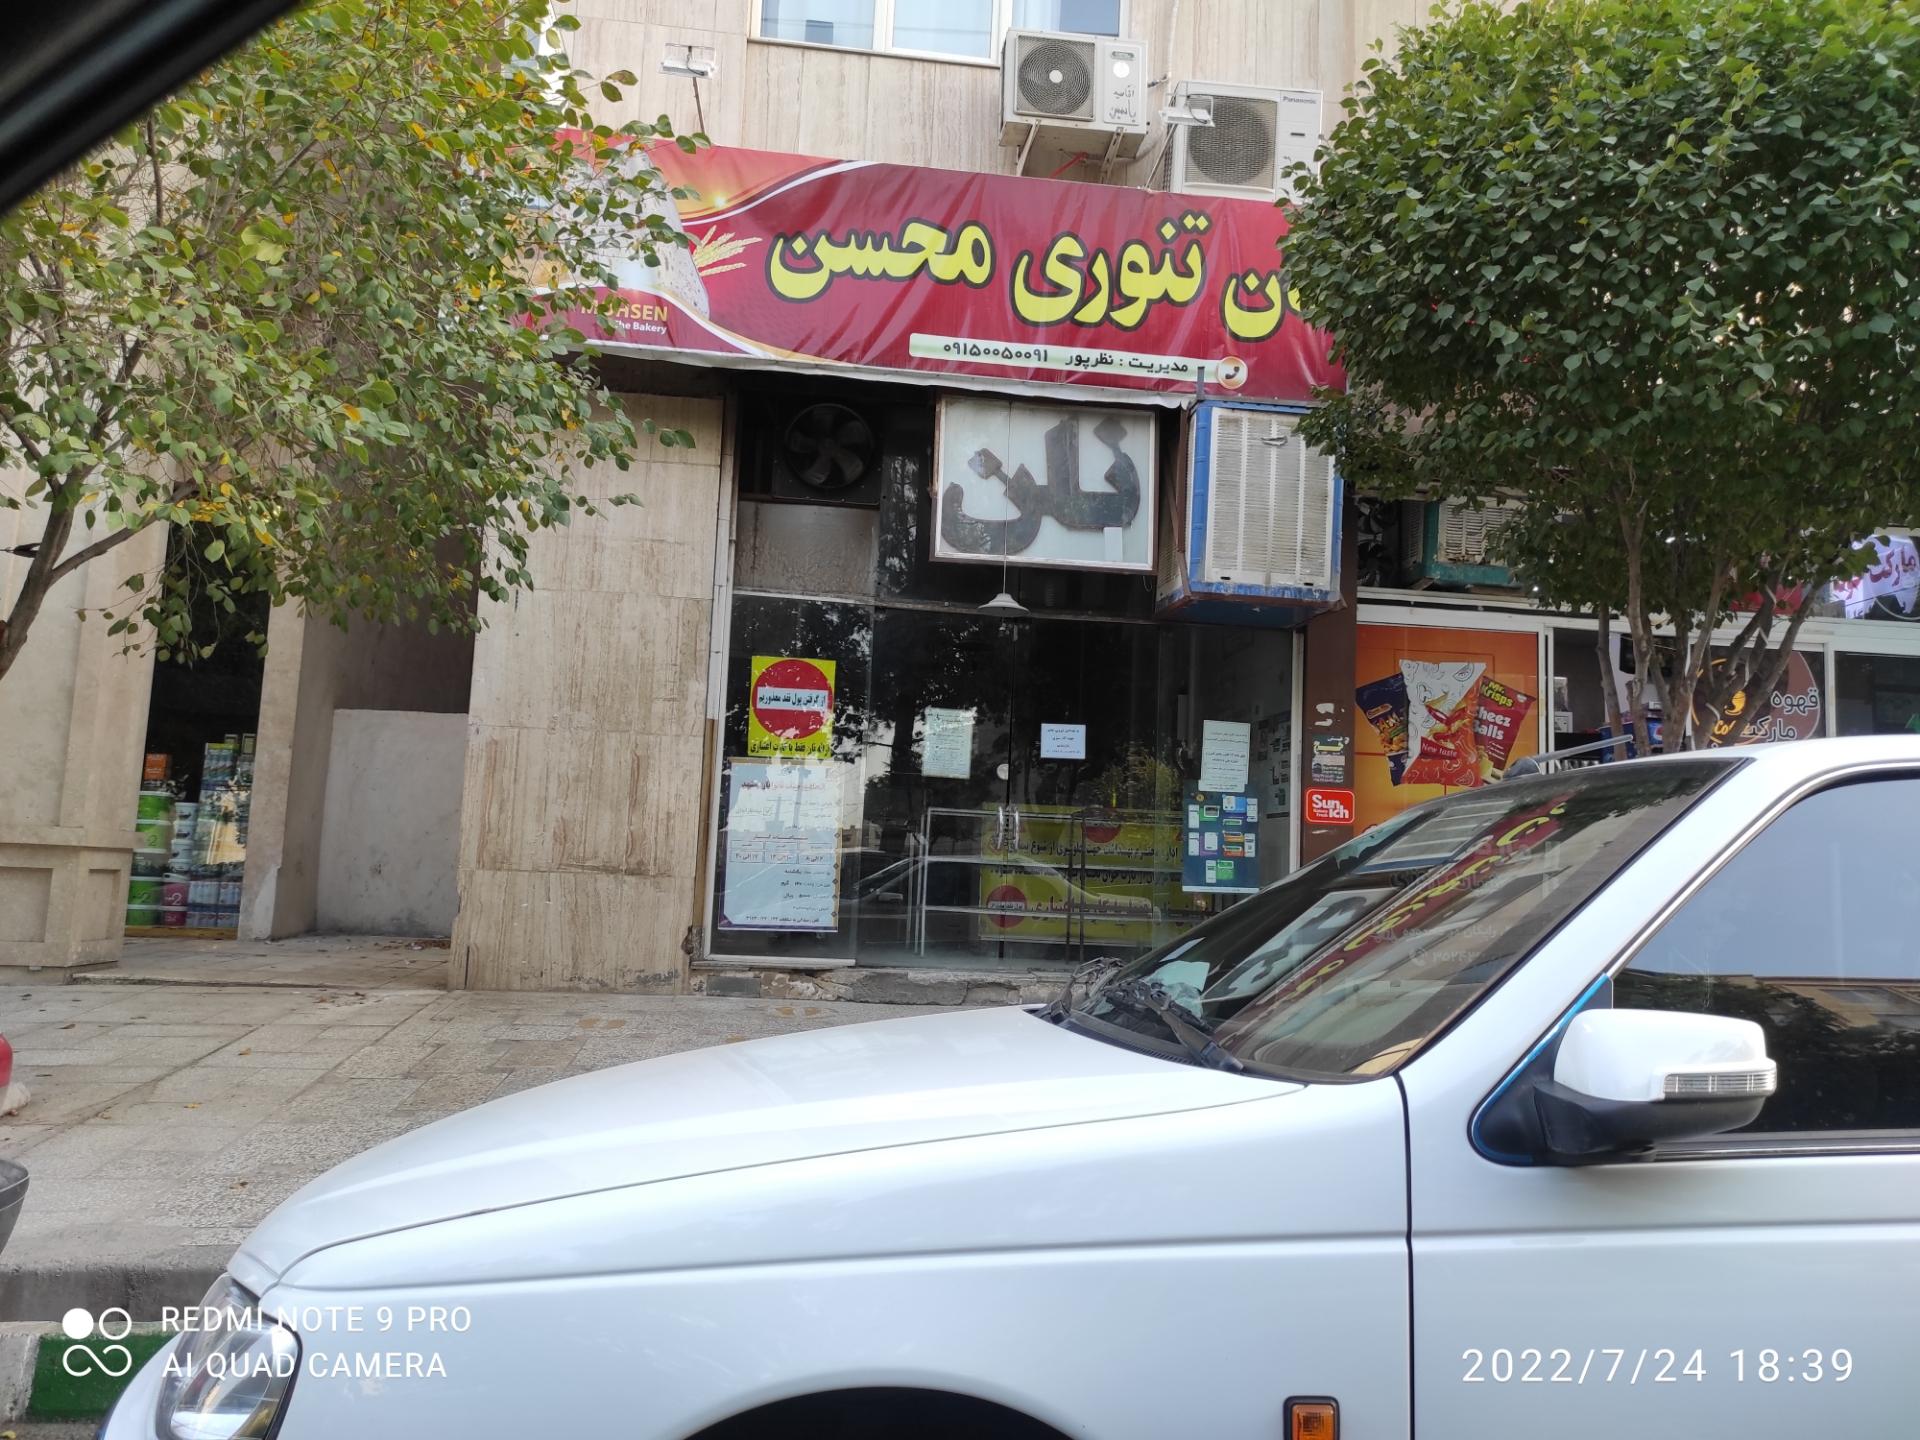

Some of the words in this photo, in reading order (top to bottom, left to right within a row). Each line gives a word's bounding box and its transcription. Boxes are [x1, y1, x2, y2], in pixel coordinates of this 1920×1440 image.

[765, 216, 997, 303] محسن
[1010, 209, 1213, 331] تنوری
[633, 321, 667, 335] Bakery
[943, 342, 1048, 362] ۰۹۱۵۰۰۵۰۰۹۱
[1065, 352, 1114, 370] نظرپور
[1128, 357, 1188, 374] مدیریت
[803, 694, 819, 707] گرفتن
[1481, 684, 1513, 708] Krisps
[1770, 688, 1819, 715] قهوه
[1476, 705, 1511, 728] heez
[1312, 794, 1341, 809] Sun
[171, 892, 182, 906] 2
